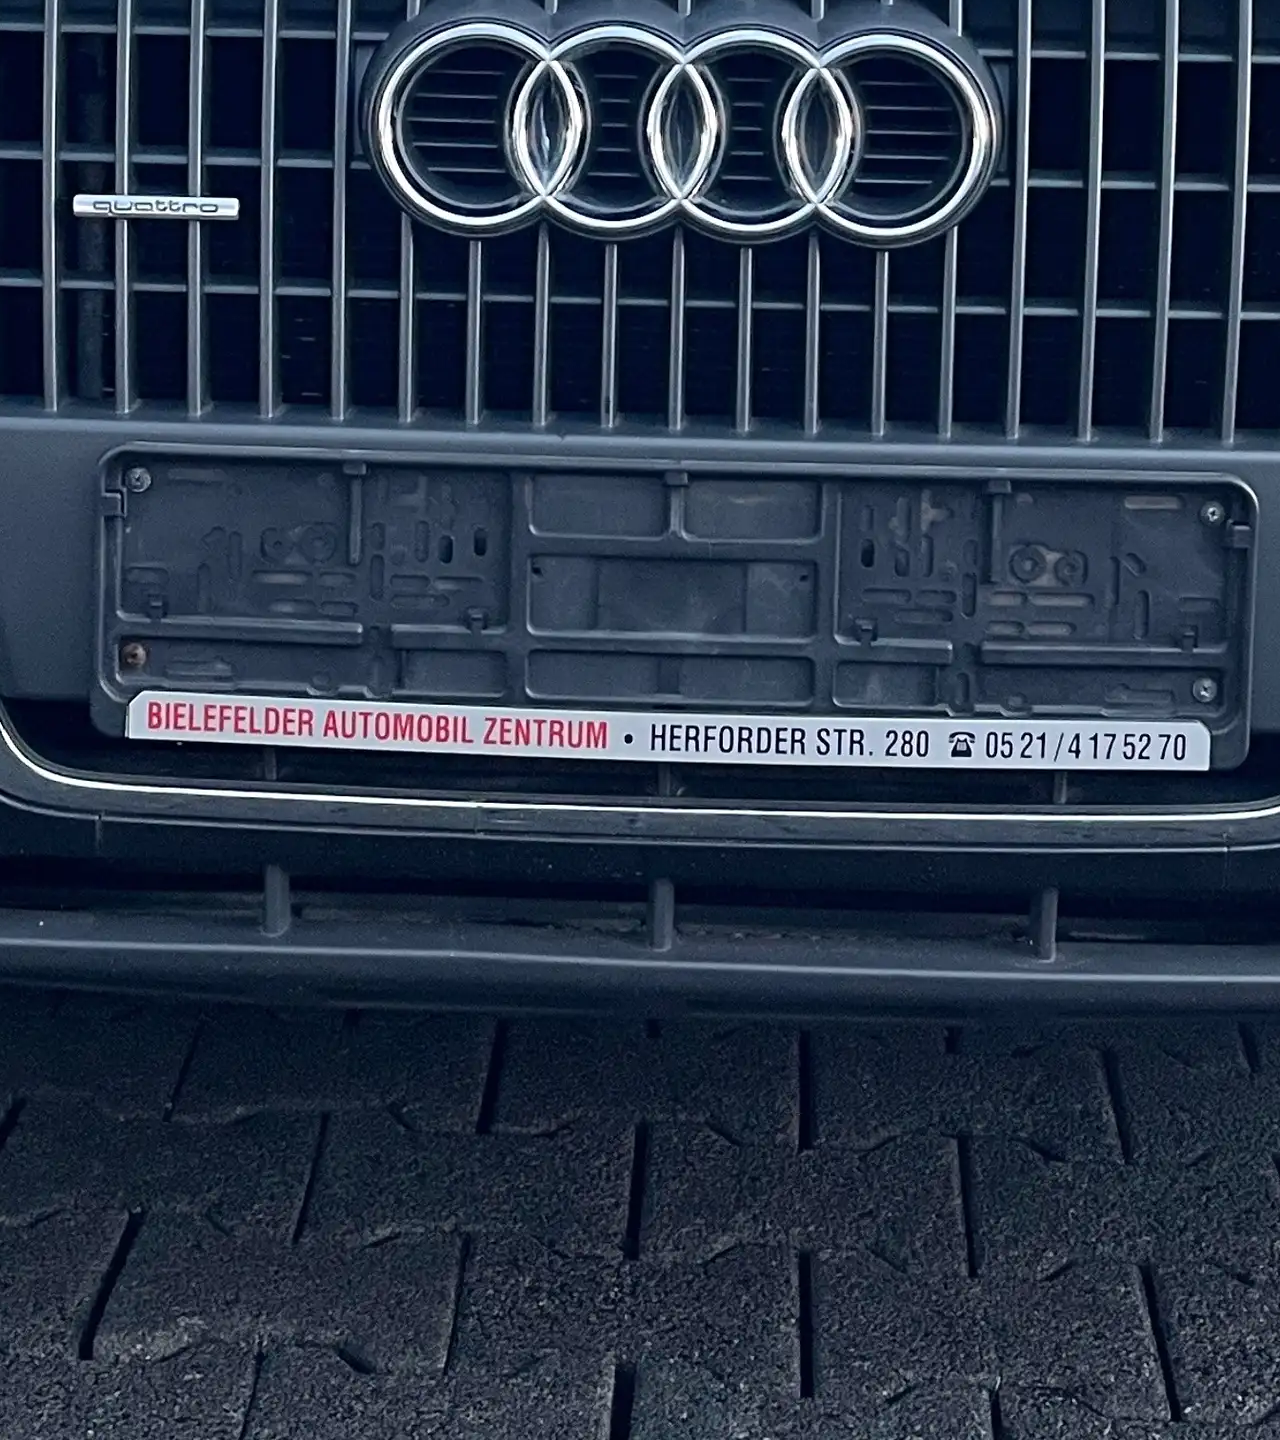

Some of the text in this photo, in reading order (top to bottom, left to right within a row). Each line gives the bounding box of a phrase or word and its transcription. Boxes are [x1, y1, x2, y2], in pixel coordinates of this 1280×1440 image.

[92, 199, 219, 215] quattro
[147, 700, 315, 737] BIELEFELDER
[322, 709, 475, 745] AUTOMOBIL
[483, 717, 609, 750] ZENTRUM
[649, 723, 807, 756] HERFORDER
[815, 727, 875, 757] STR.
[884, 730, 931, 759] 280
